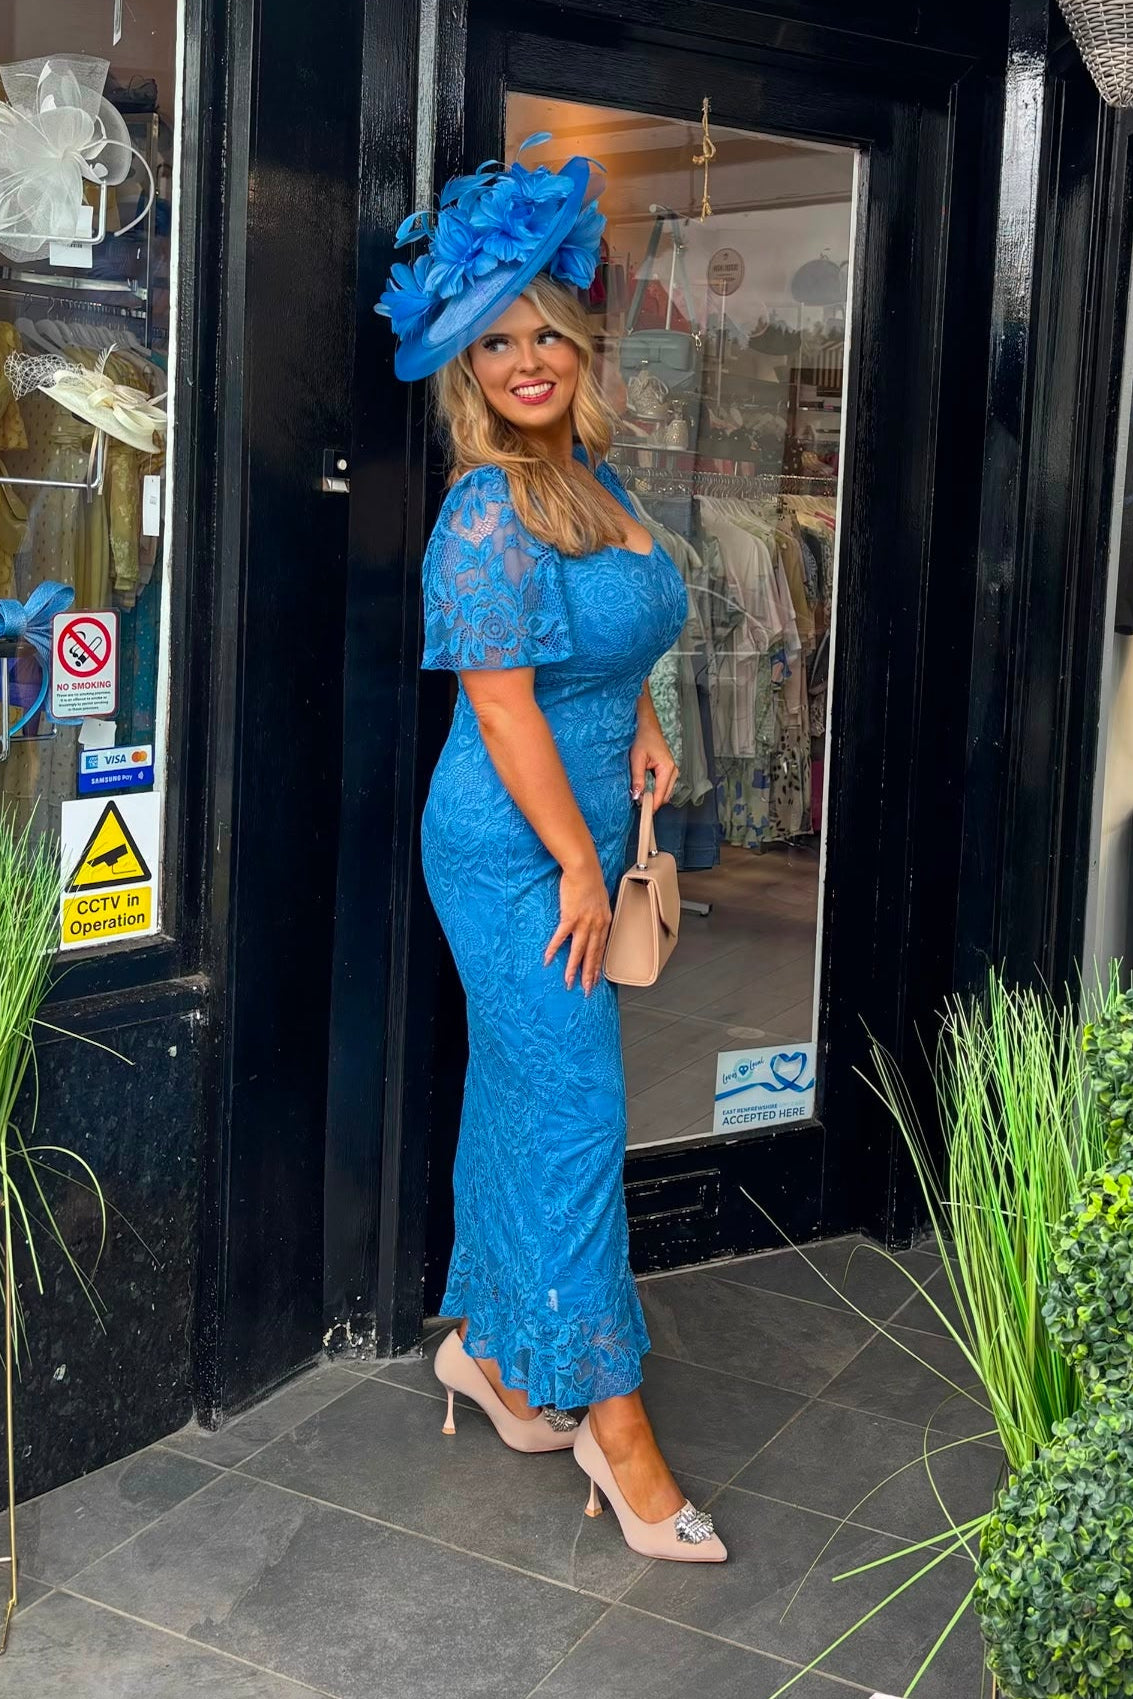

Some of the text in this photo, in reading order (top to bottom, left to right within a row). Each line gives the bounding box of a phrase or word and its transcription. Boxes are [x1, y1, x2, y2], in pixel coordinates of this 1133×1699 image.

[72, 681, 111, 690] SMOKING
[104, 754, 126, 764] VISA
[91, 775, 121, 784] SAMSUNG
[77, 894, 139, 914] CCTV in
[70, 913, 145, 936] Operation
[736, 1104, 778, 1113] RENFREWSHIRE
[722, 1106, 805, 1126] ACCEPTED HERE
